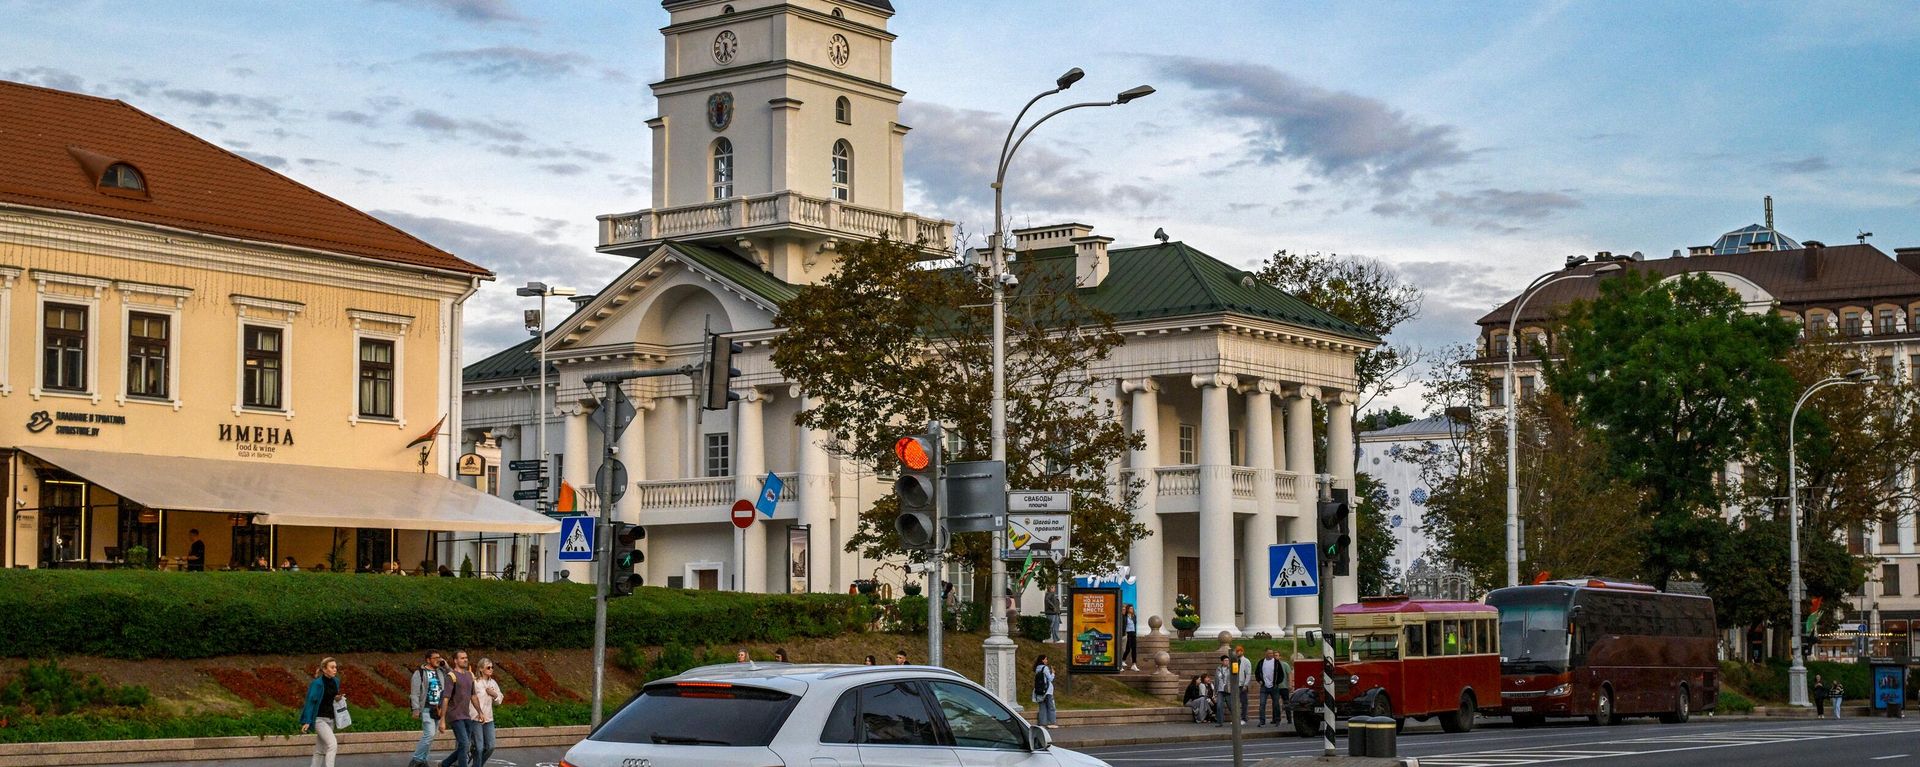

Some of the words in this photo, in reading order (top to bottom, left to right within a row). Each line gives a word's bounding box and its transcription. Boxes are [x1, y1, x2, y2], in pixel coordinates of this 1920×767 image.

[219, 424, 294, 445] ИМЕНА
[236, 442, 251, 451] food
[259, 445, 275, 453] wine
